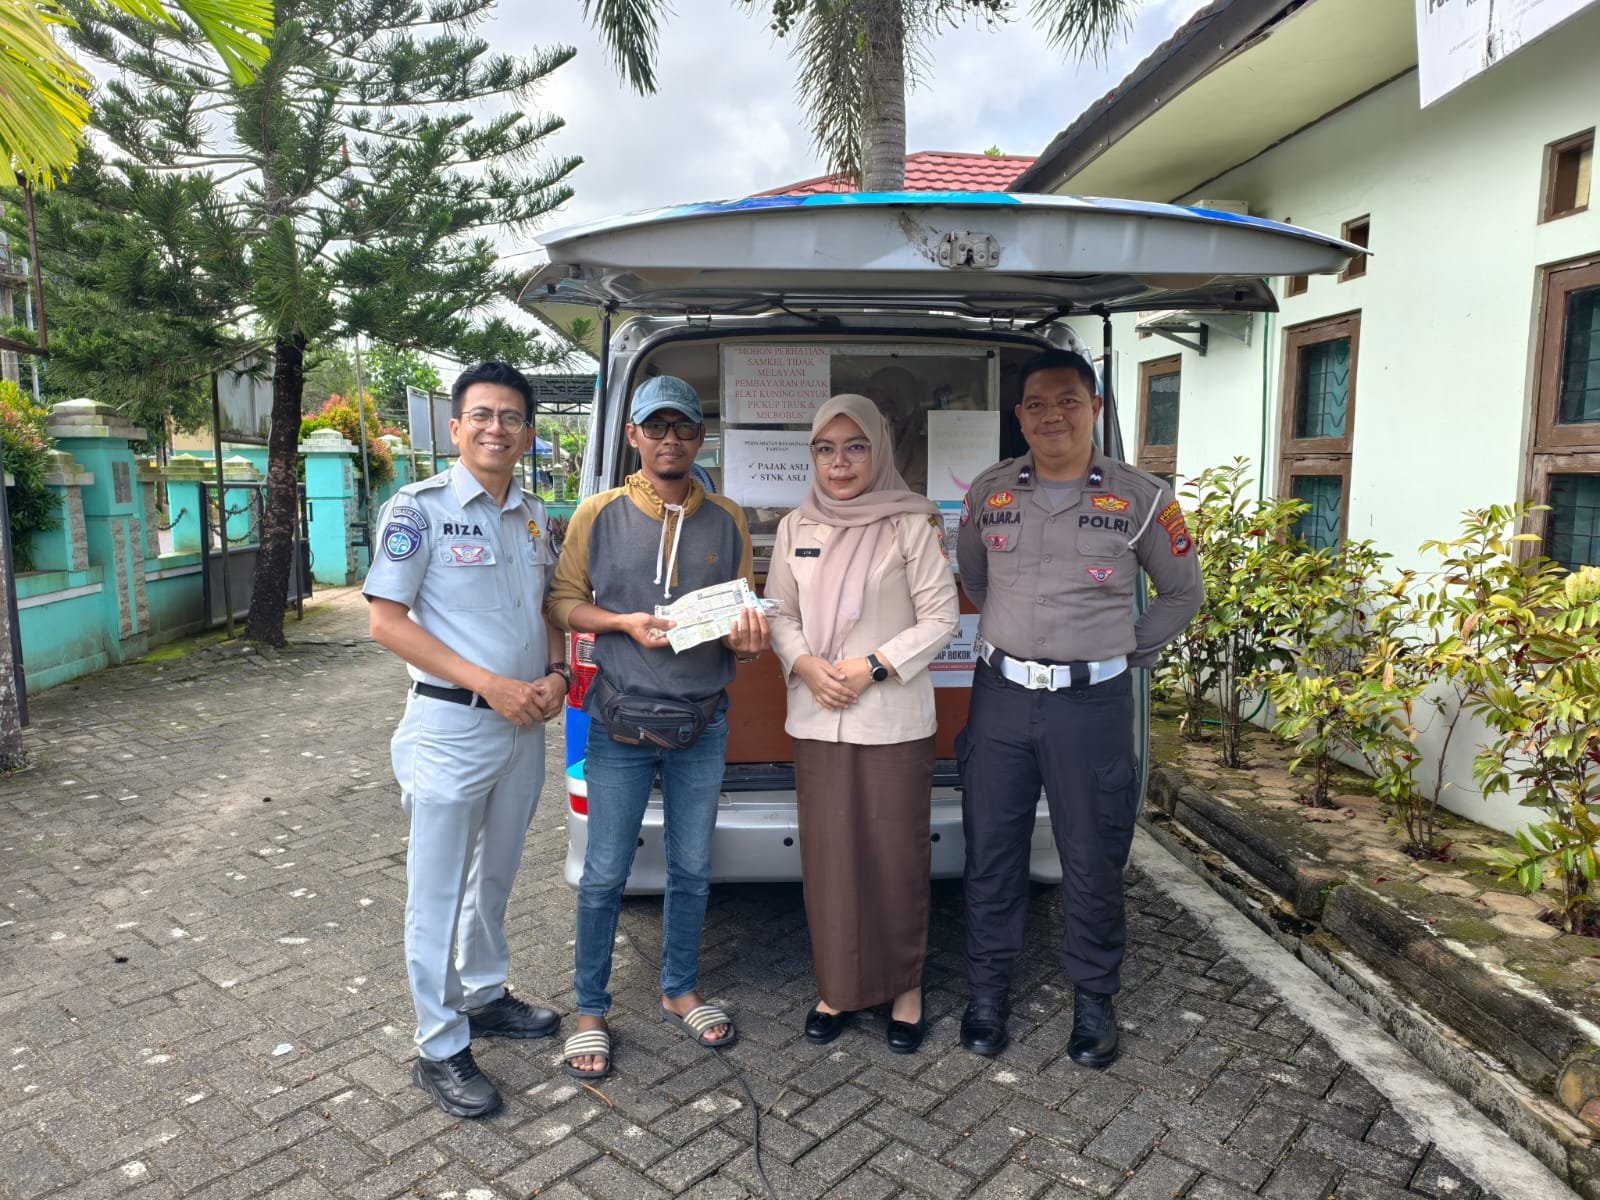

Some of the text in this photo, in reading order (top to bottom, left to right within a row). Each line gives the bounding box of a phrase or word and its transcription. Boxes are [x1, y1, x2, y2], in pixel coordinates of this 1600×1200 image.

[788, 358, 815, 366] TIDAK
[757, 368, 805, 376] MELAYANI
[736, 379, 828, 388] PEMBAYARAN PAJAK
[736, 390, 828, 398] PLAT KUNING UNTUK
[748, 401, 782, 409] PICKUP
[784, 401, 807, 409] TRUK
[1078, 514, 1129, 534] POLRI
[444, 522, 483, 536] RIZA
[948, 650, 971, 660] ROKOK
